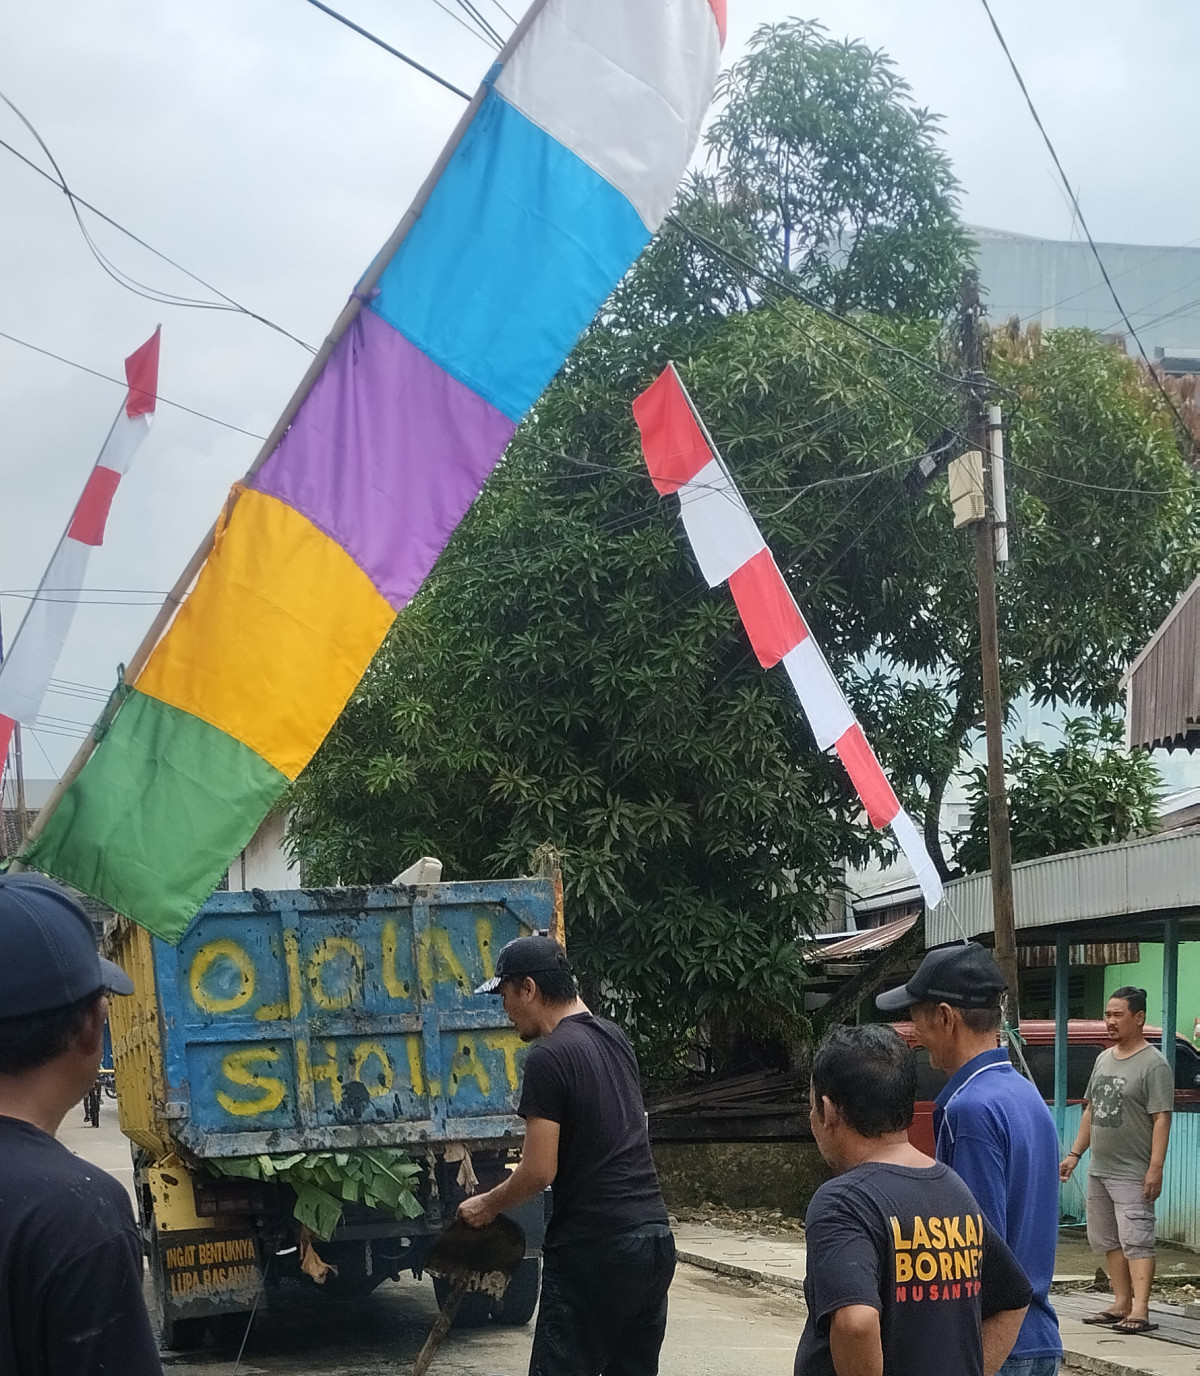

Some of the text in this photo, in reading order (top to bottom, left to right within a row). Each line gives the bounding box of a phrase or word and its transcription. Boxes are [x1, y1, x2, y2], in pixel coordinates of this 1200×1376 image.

[216, 1034, 532, 1117] SHOLAT
[166, 1238, 256, 1269] INGAT BENTUKNYA
[895, 1249, 983, 1282] BORNE
[170, 1271, 199, 1298] LUPA
